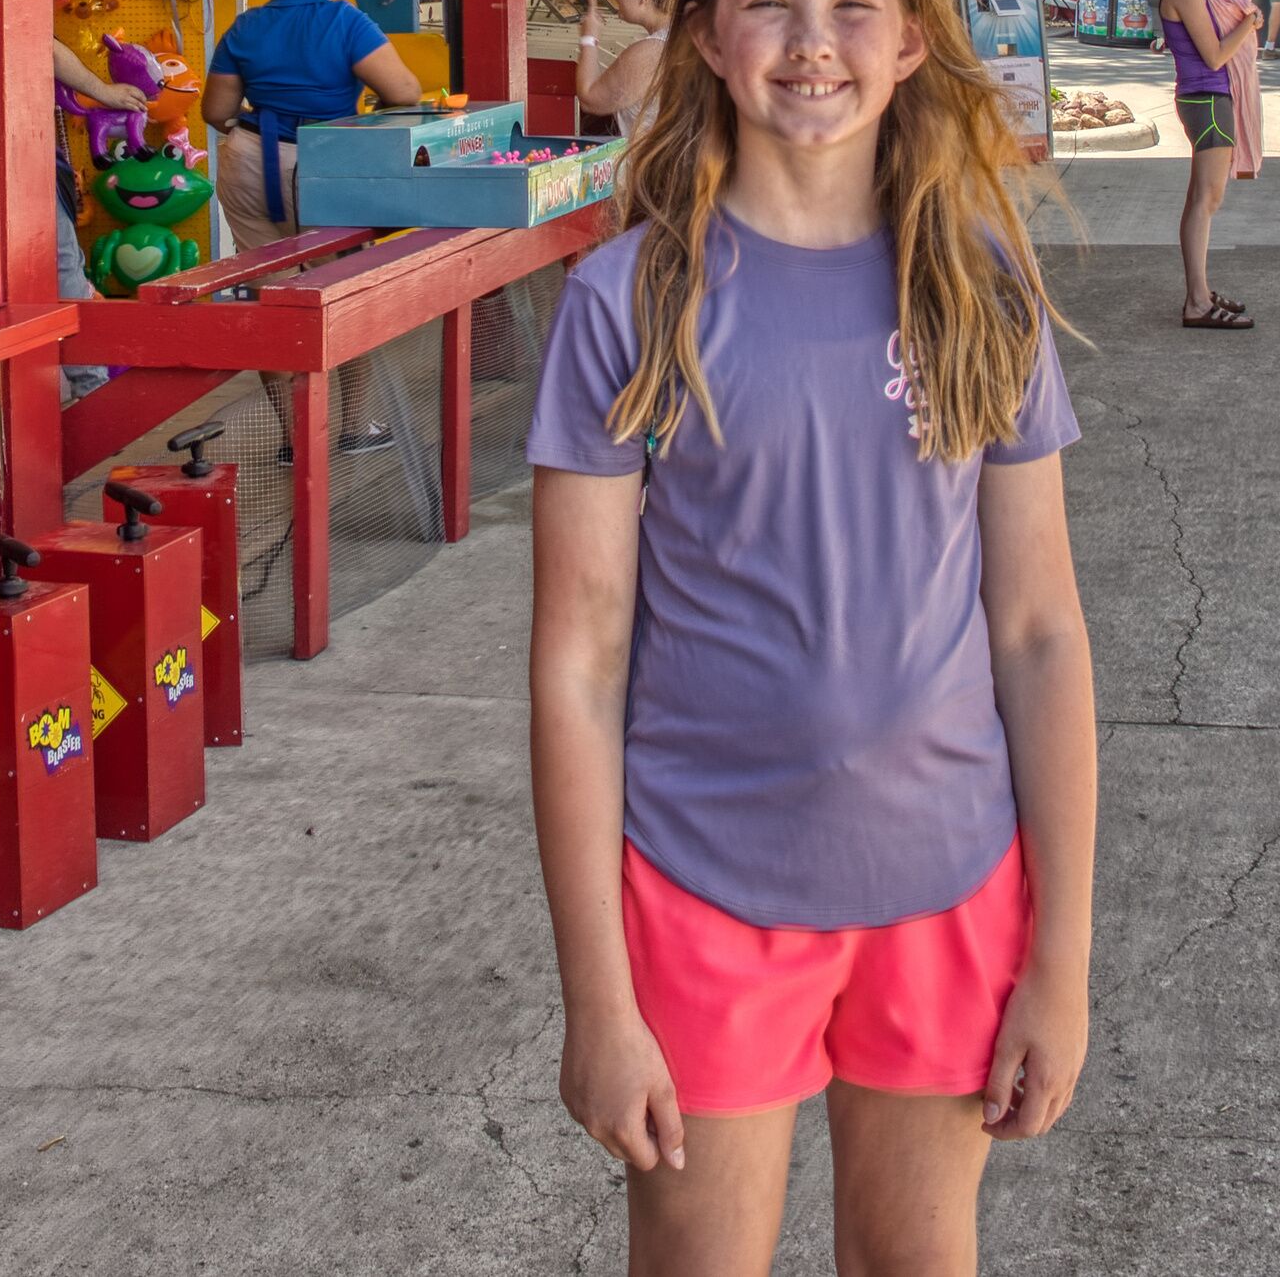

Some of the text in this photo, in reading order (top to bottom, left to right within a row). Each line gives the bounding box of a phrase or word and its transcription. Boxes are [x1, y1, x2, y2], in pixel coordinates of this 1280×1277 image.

[545, 160, 612, 210] DUCK POND
[155, 648, 186, 686] BOOM
[168, 672, 194, 702] BLASTER
[29, 708, 70, 749] BOOM
[47, 734, 81, 766] BLASTER
